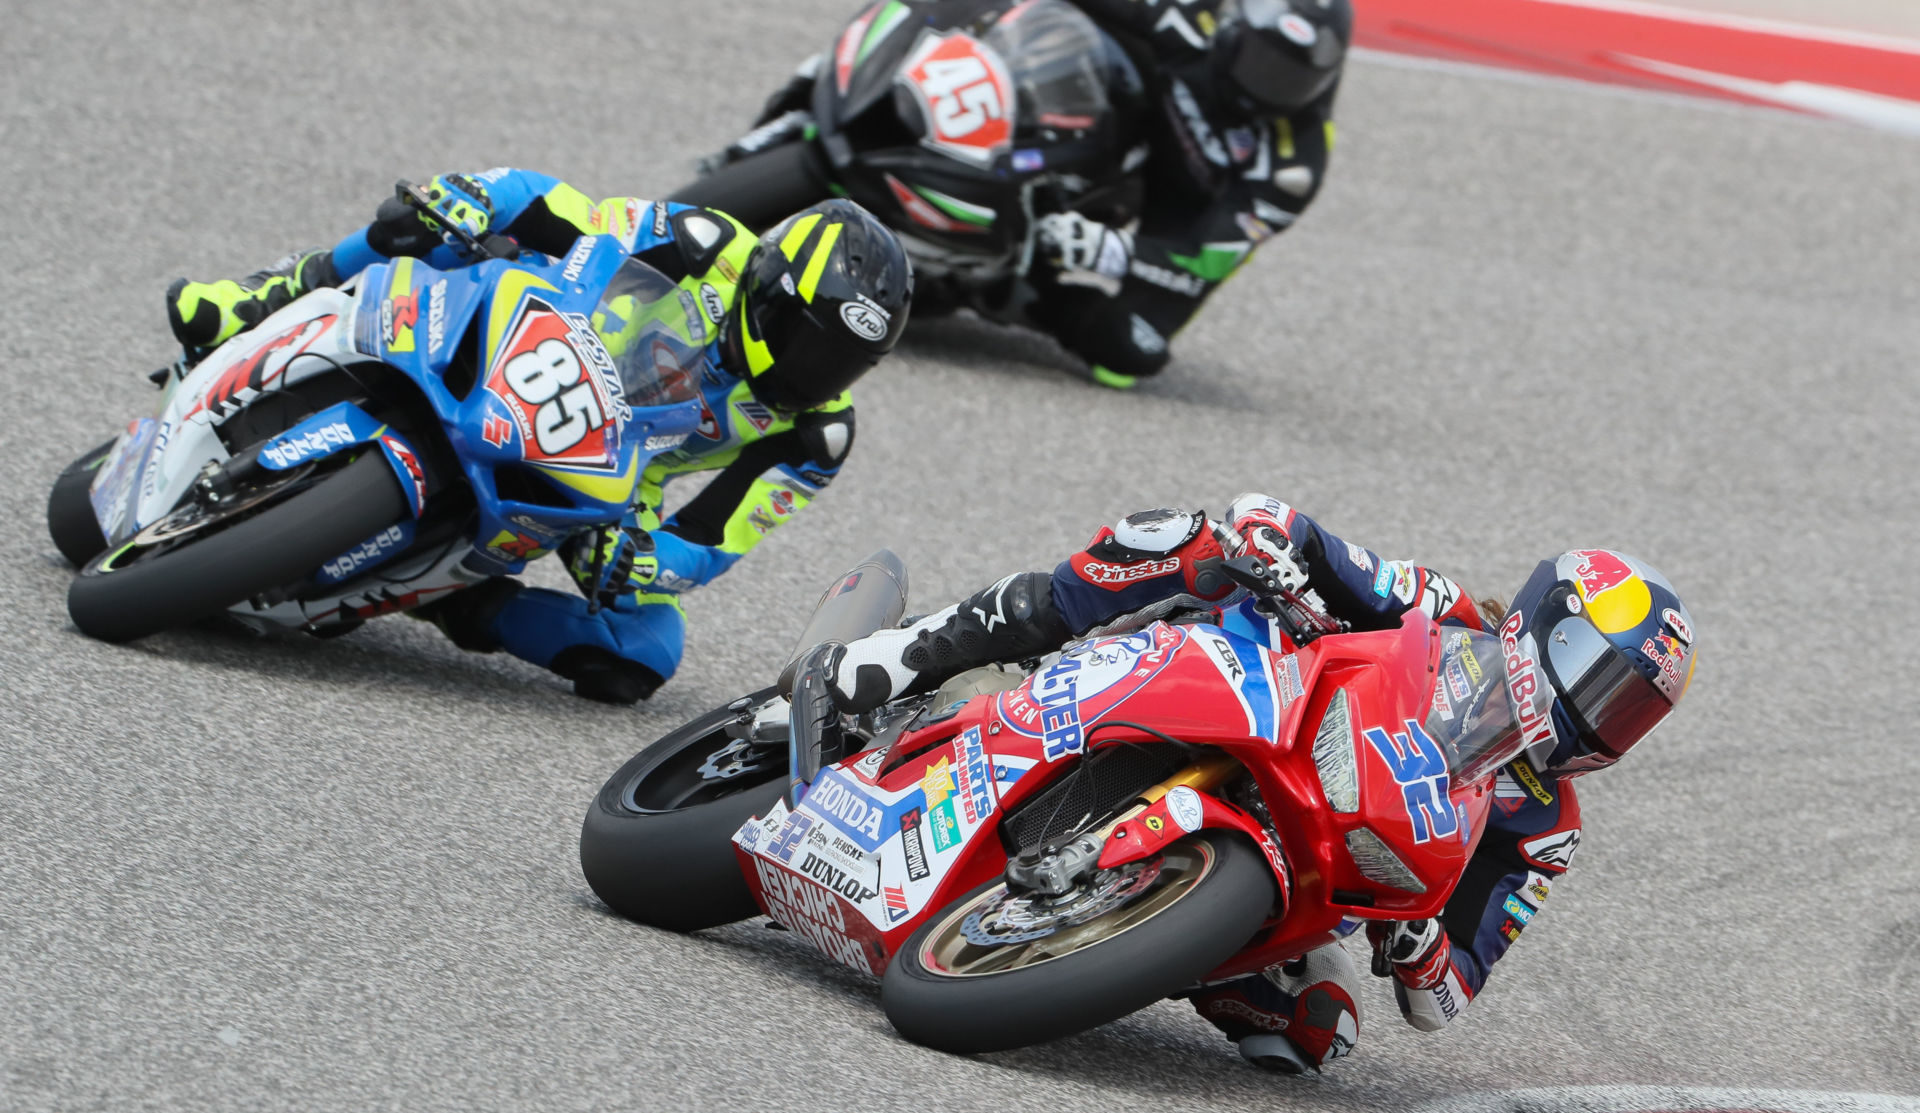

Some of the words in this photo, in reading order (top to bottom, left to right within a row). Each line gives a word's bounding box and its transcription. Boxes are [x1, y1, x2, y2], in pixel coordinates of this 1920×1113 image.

[922, 56, 1001, 139] 45
[562, 235, 598, 282] SUZUKI
[428, 278, 449, 355] SUZUKI
[503, 337, 606, 457] 85
[1212, 638, 1245, 679] CBR
[1500, 610, 1533, 677] Red
[952, 733, 978, 825] UNLIMITED
[963, 724, 993, 821] PARTS
[1363, 719, 1459, 845] 32
[1519, 766, 1551, 803] DUNLOP
[810, 773, 885, 842] HONDA
[800, 851, 878, 905] DUNLOP
[831, 836, 864, 861] PENSKE
[754, 854, 846, 933] CHICKEN
[1432, 979, 1460, 1023] ONDA
